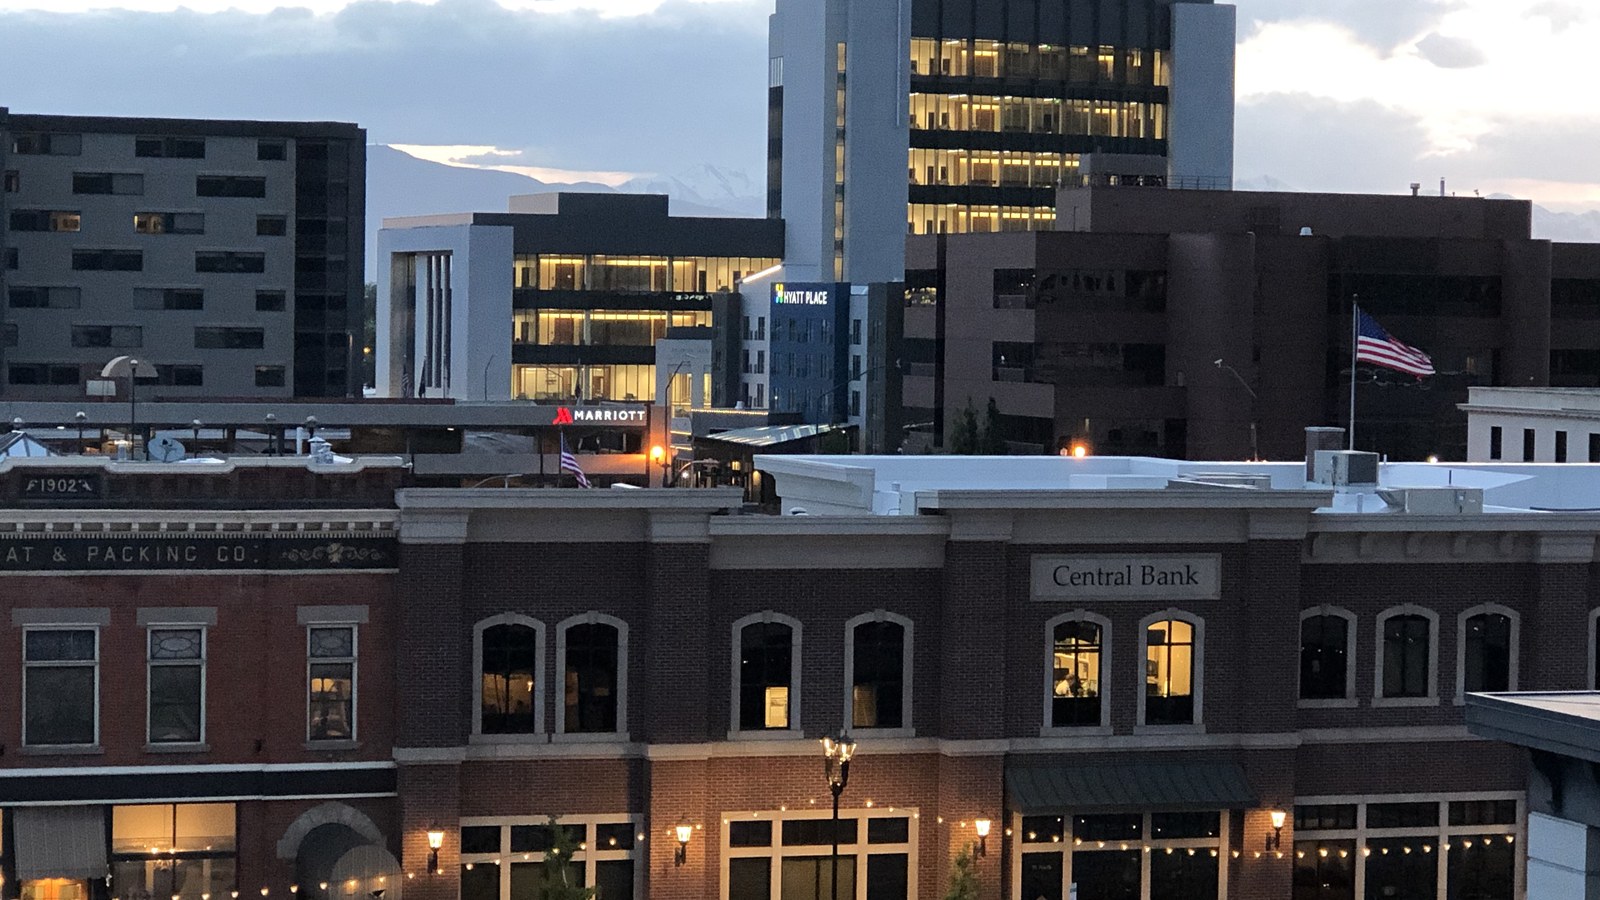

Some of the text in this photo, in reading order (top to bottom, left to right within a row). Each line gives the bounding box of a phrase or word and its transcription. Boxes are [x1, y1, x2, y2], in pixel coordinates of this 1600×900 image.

[783, 291, 828, 305] HYATT PLACE
[574, 410, 646, 421] MARRIOTT
[40, 479, 77, 492] 1902
[52, 546, 67, 562] &
[87, 546, 197, 562] PACKING
[1052, 565, 1199, 586] Central Bank
